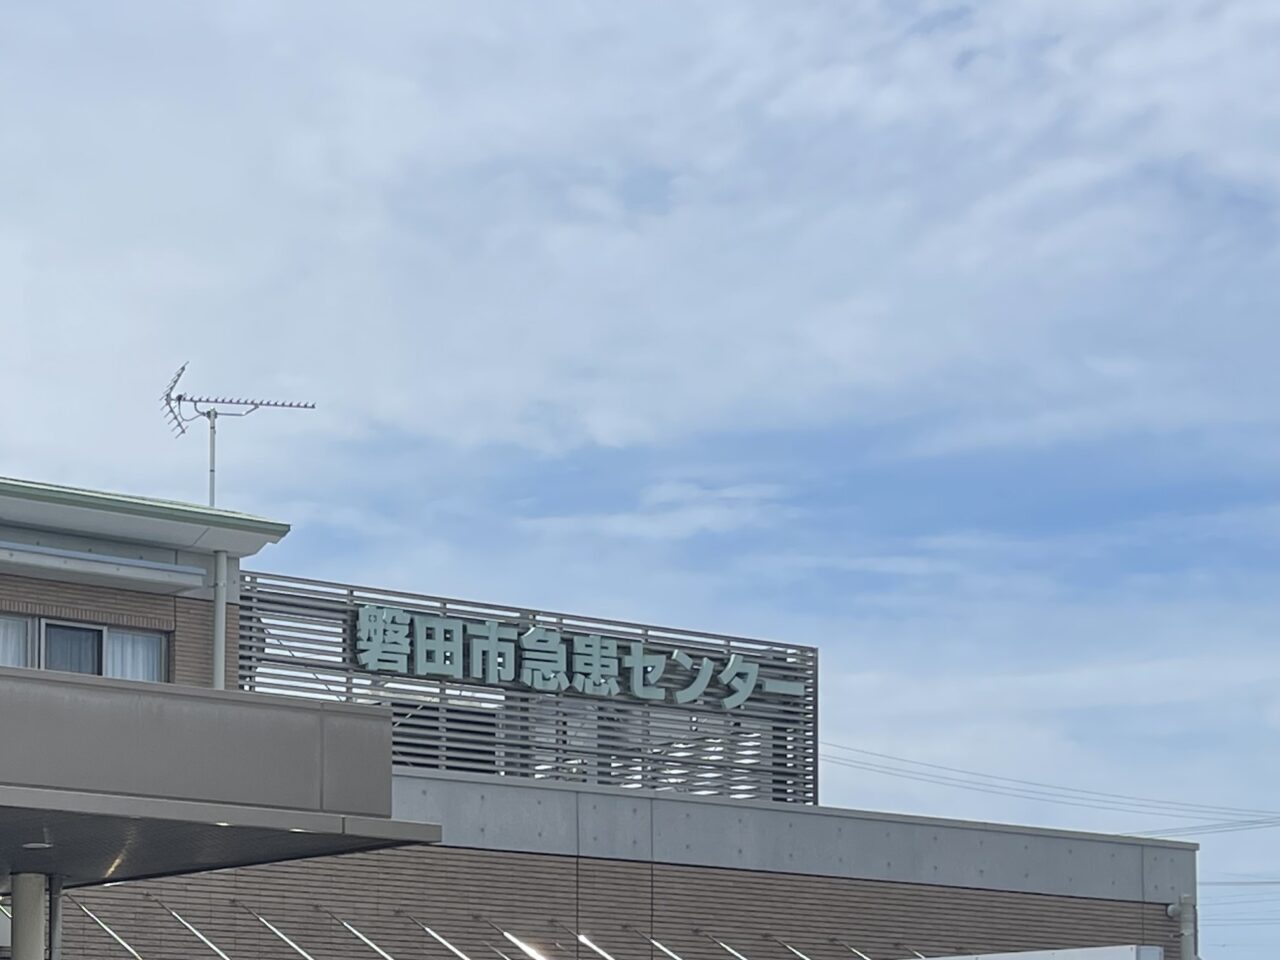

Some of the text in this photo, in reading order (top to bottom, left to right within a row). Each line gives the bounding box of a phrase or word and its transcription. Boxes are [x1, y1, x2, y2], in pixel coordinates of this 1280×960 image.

[356, 604, 805, 709] 磐田市急患センター
